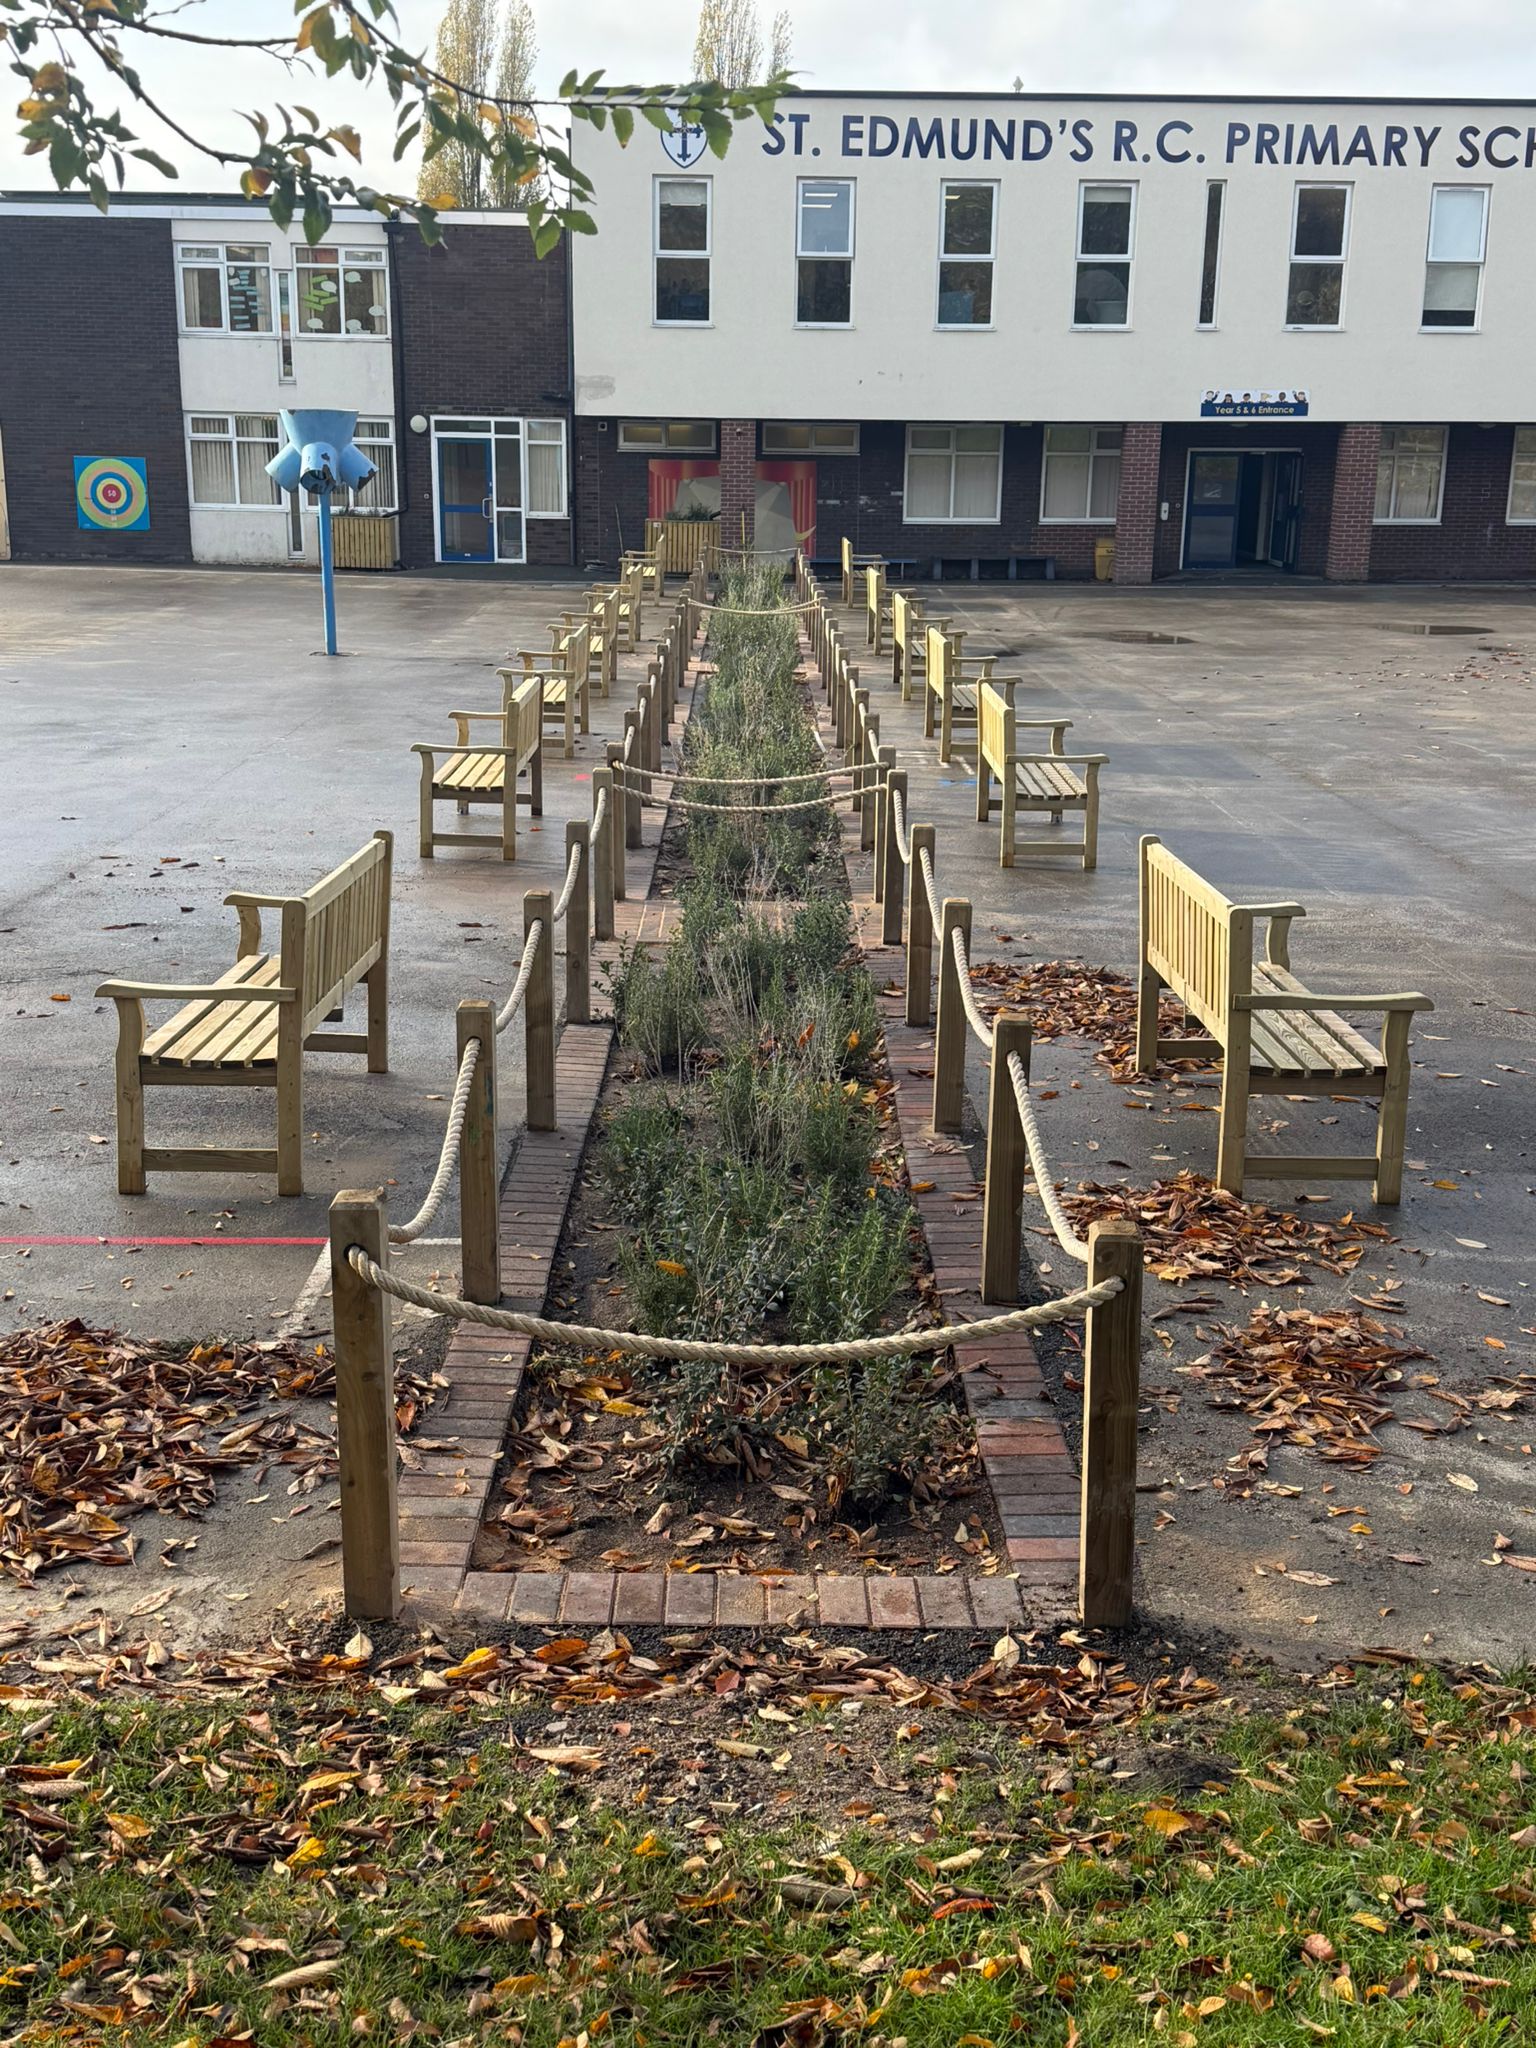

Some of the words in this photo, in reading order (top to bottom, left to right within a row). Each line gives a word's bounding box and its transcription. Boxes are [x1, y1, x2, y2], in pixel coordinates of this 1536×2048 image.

[762, 112, 821, 156] ST.
[841, 115, 1094, 162] EDMUND'S
[1113, 120, 1205, 164] R.C.
[1226, 122, 1442, 167] PRIMARY
[1215, 406, 1234, 414] Year
[1236, 406, 1241, 414] 5
[1243, 406, 1249, 414] &
[1251, 406, 1256, 414] 6
[1258, 406, 1294, 414] Entrance
